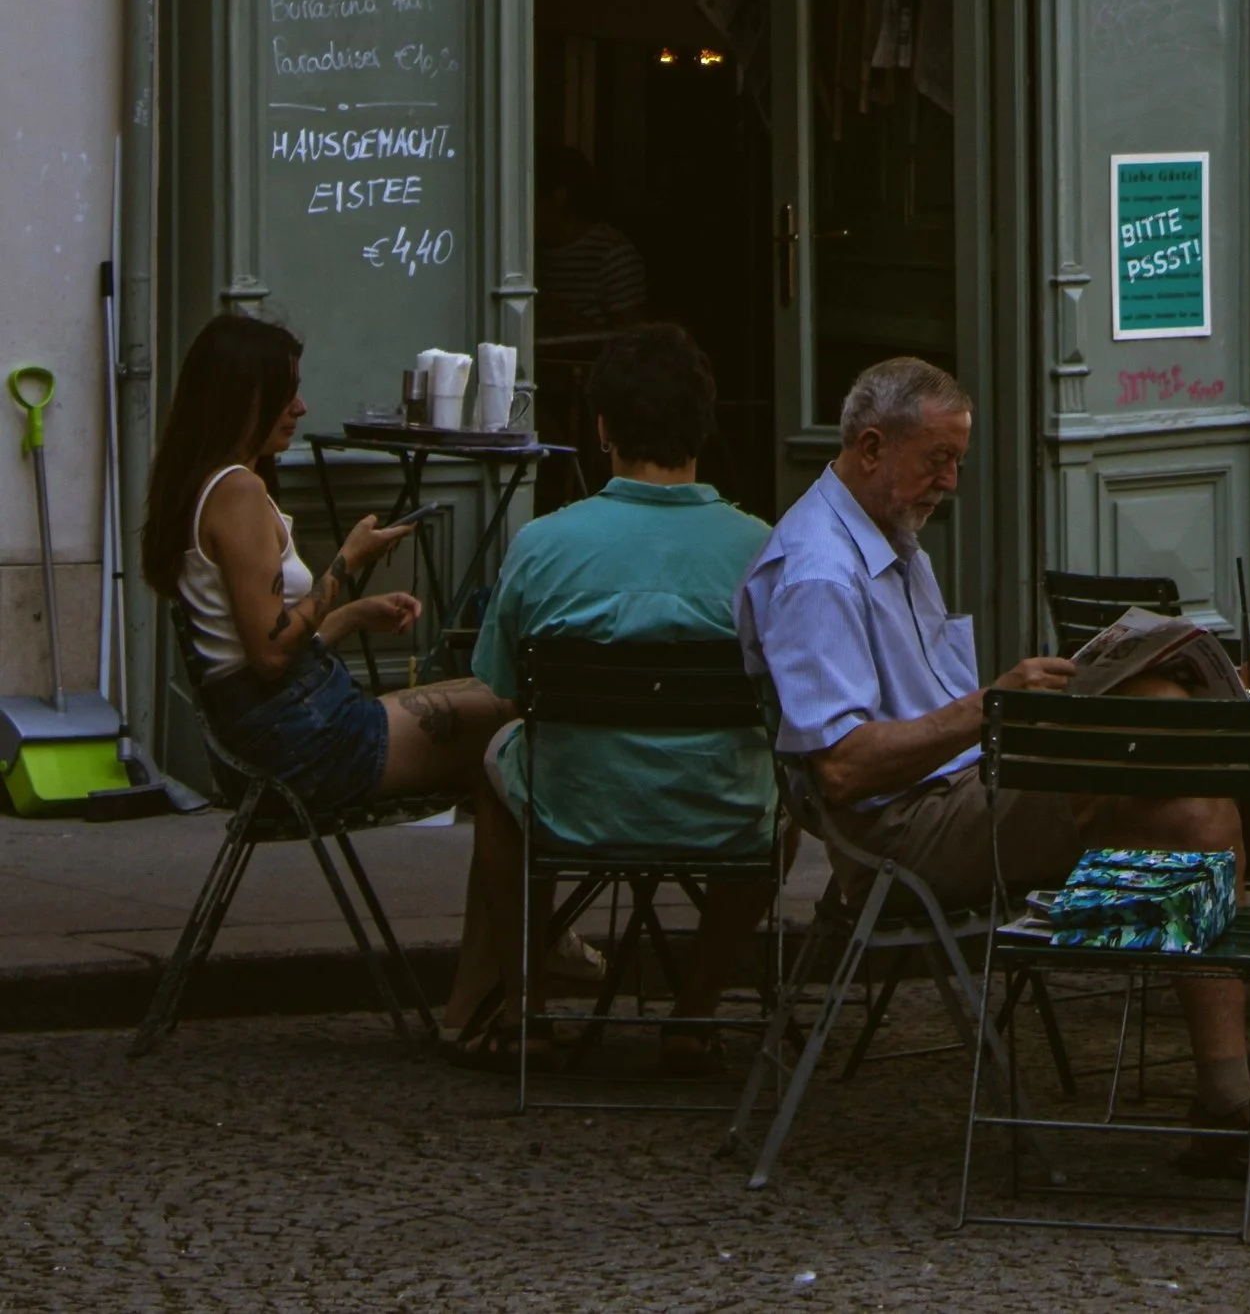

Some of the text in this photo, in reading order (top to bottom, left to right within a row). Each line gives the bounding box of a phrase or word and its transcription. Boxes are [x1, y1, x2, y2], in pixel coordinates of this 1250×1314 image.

[308, 176, 423, 214] EISTEE
[1121, 208, 1183, 248] BITTE
[1127, 238, 1203, 284] PSSST!
